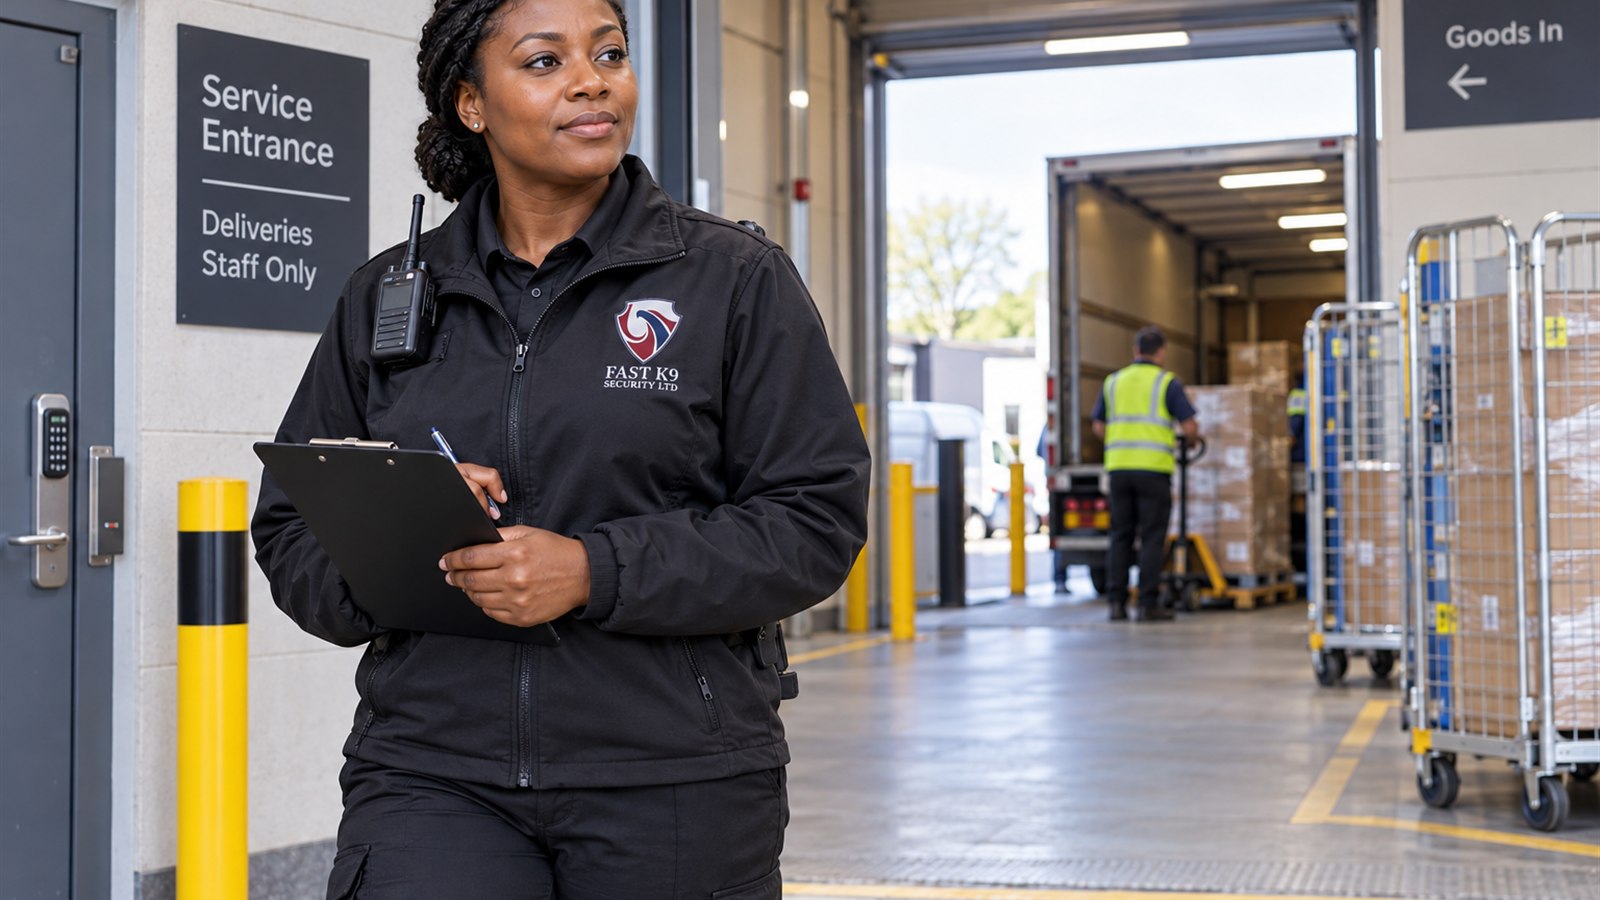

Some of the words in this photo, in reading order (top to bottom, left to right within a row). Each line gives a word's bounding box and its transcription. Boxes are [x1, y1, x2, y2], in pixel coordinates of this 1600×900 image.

[1445, 20, 1532, 49] Goods
[1539, 19, 1563, 43] In
[201, 73, 313, 122] Service
[202, 117, 334, 168] Entrance
[202, 208, 313, 247] Deliveries
[201, 249, 260, 280] Staff
[265, 255, 318, 292] Only
[603, 380, 655, 390] SECURITY
[658, 382, 678, 391] LTD
[605, 366, 651, 379] FAST
[656, 367, 679, 382] K9
